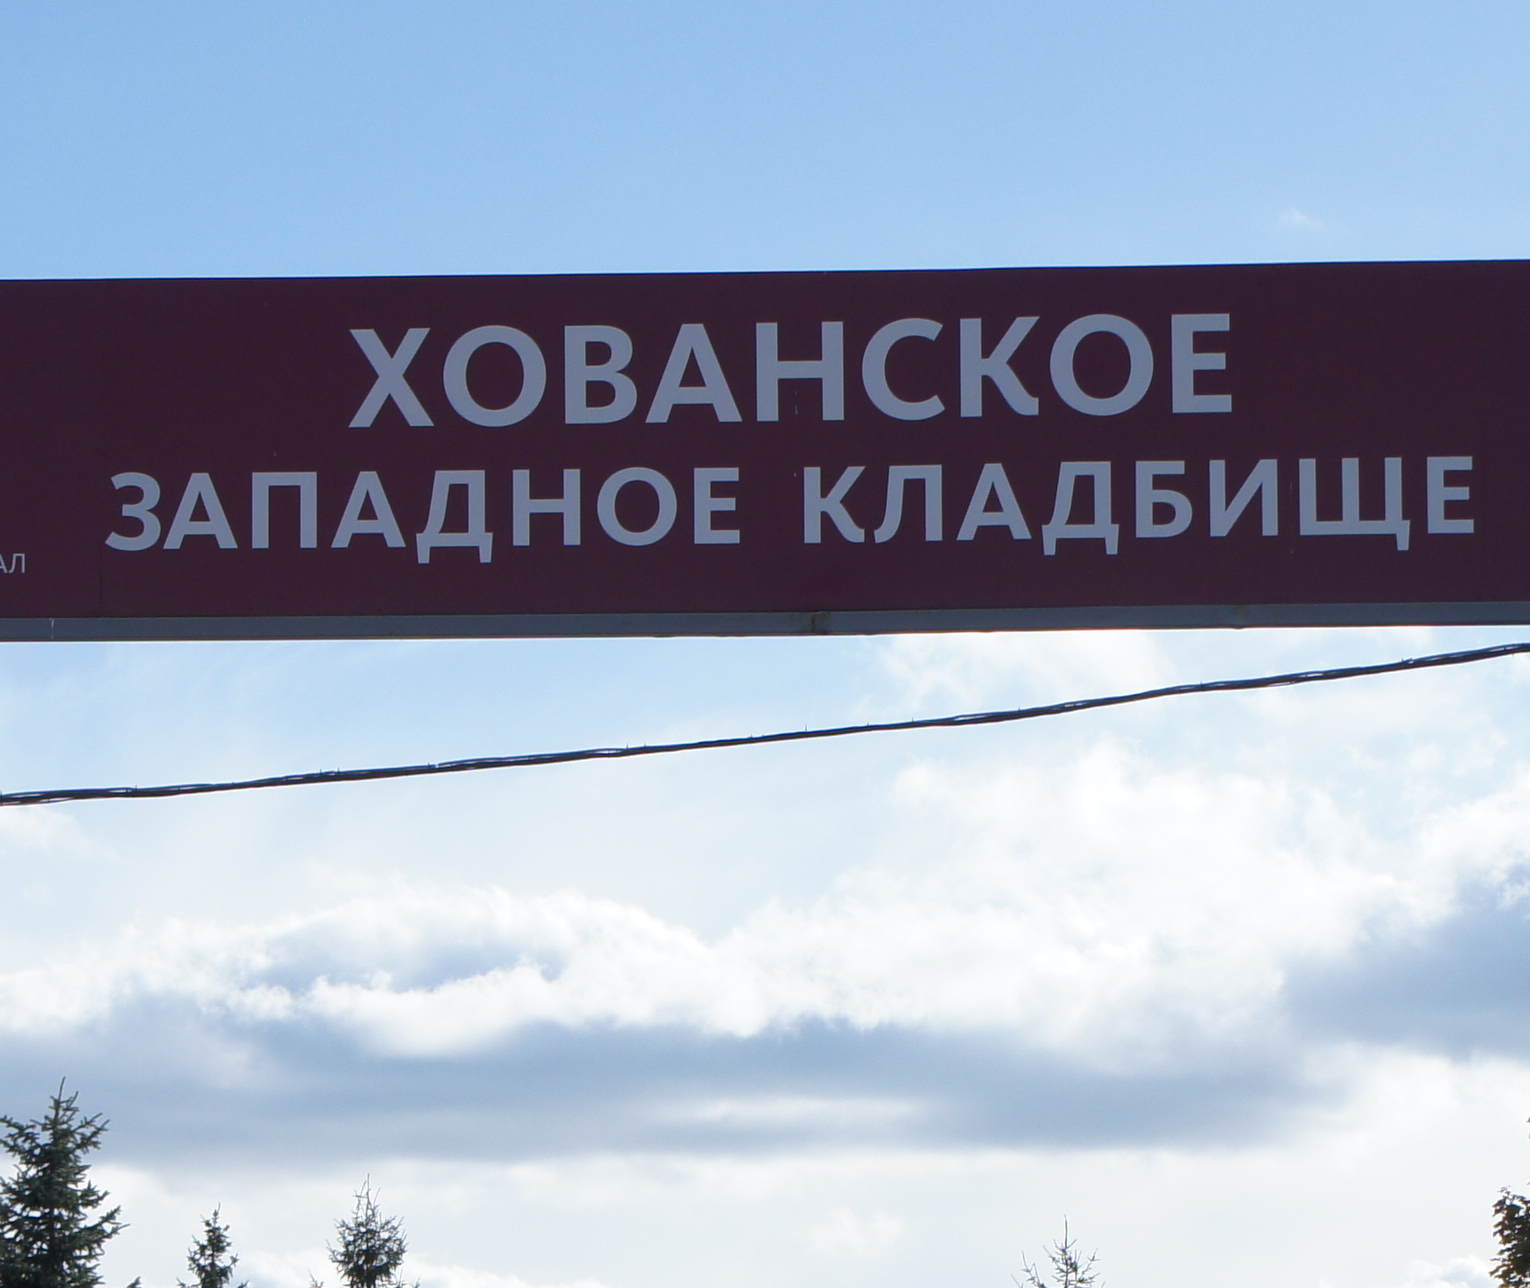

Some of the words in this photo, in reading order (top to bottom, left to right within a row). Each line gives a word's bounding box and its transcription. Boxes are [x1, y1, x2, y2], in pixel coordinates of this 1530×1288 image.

[349, 313, 1232, 428] ХОВАНСКОЕ
[105, 467, 740, 562] ЗАПАДНОЕ
[800, 456, 1474, 553] КЛАДБИЩЕ
